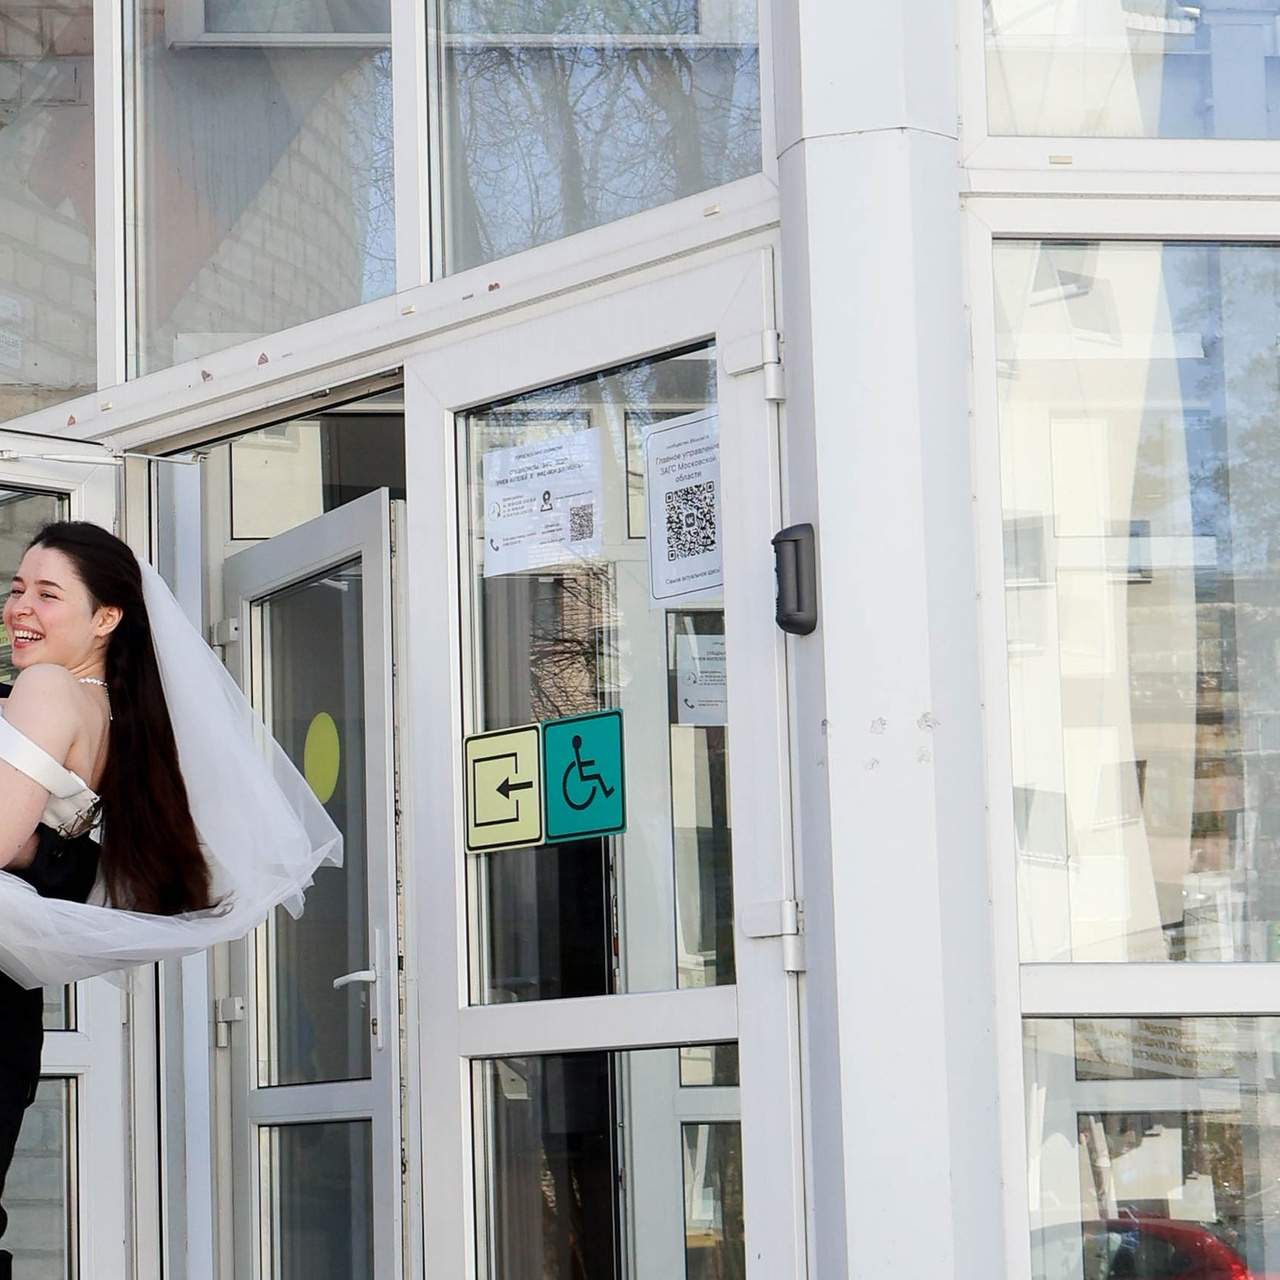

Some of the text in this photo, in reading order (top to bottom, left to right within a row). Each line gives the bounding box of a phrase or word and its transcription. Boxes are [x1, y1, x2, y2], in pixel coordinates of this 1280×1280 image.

[656, 453, 682, 466] Главное
[660, 454, 716, 476] ЗАГС Московской
[675, 470, 702, 483] области
